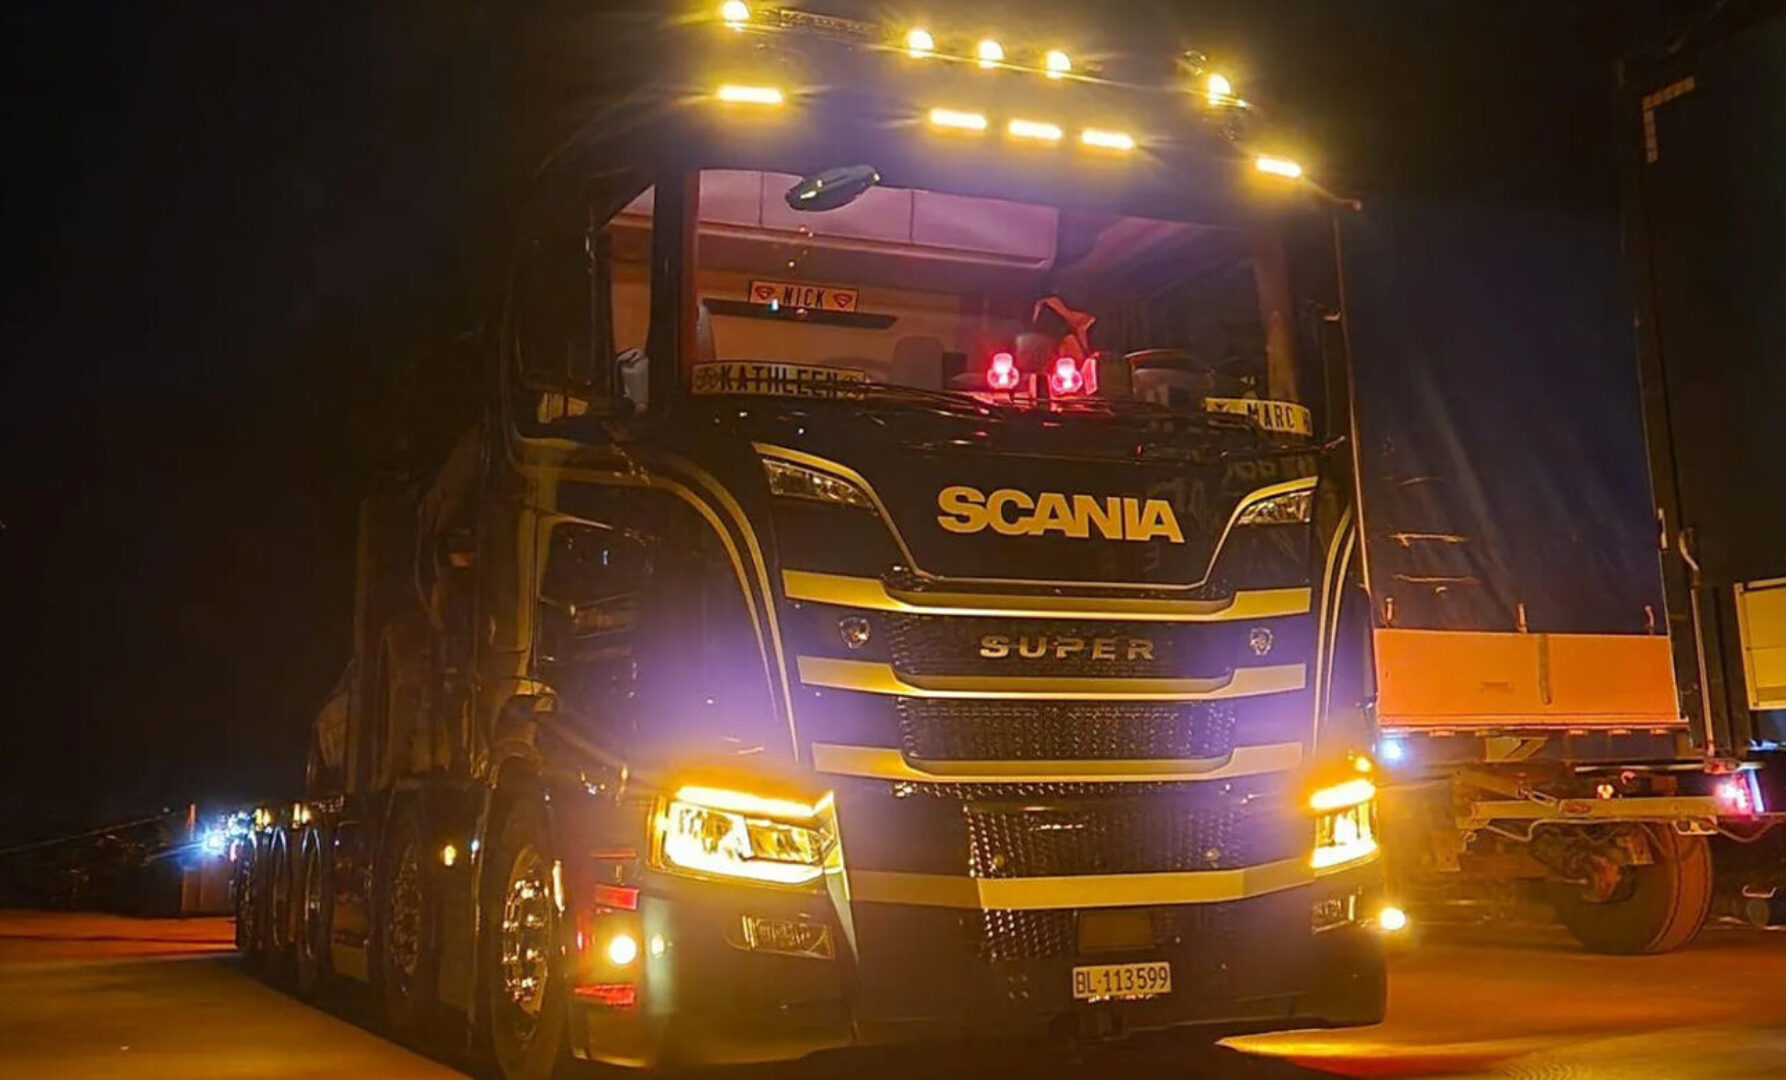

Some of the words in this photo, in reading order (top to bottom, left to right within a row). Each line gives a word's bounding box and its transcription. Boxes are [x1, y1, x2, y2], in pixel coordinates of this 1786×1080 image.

[783, 286, 825, 308] NICK
[720, 365, 838, 398] KATHLEEN
[937, 485, 1185, 543] SCANIA
[980, 636, 1154, 660] SUPER
